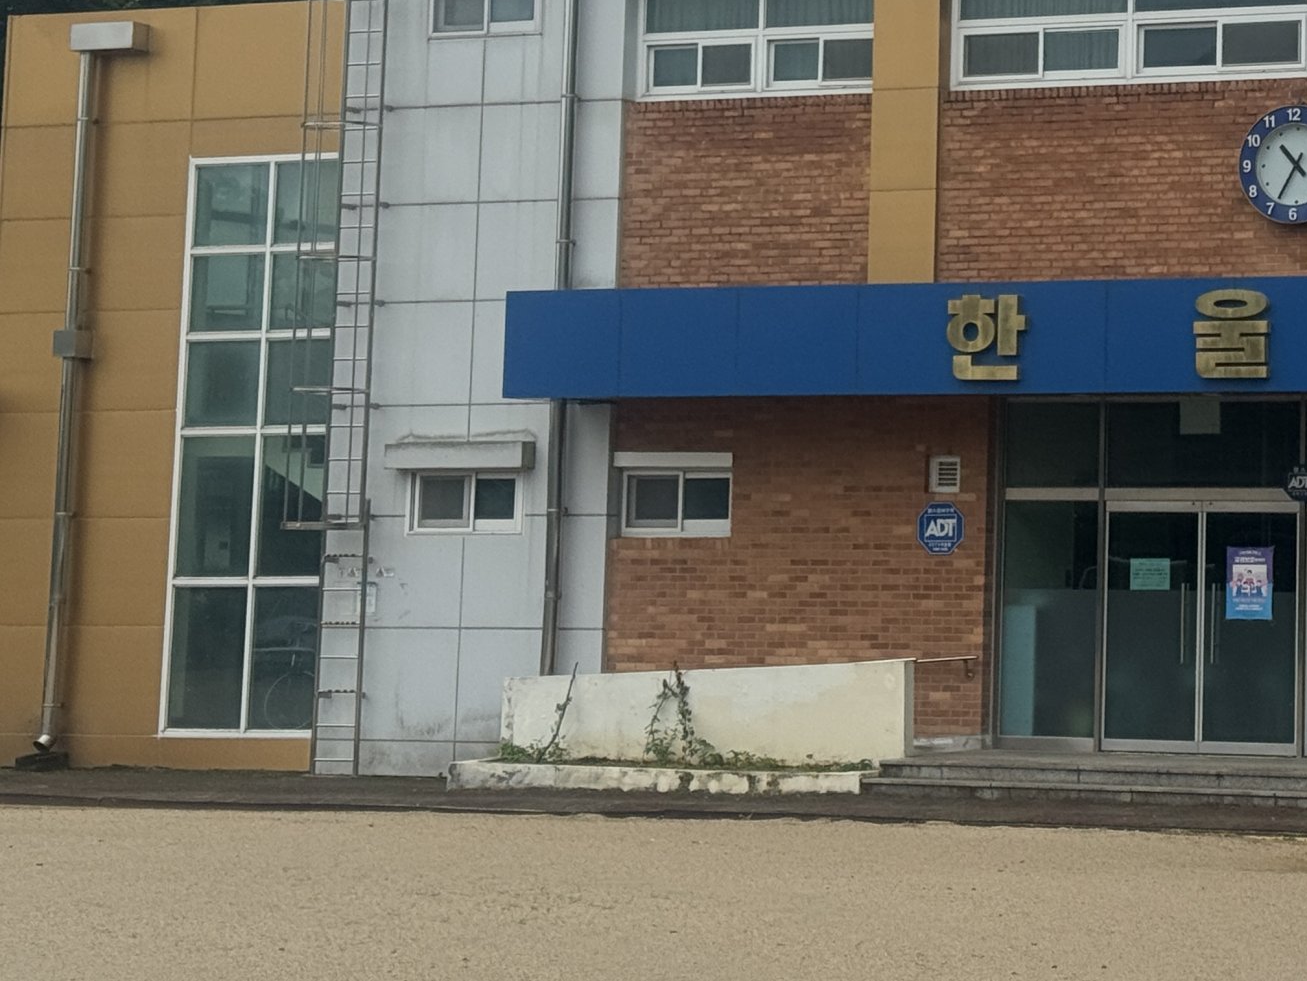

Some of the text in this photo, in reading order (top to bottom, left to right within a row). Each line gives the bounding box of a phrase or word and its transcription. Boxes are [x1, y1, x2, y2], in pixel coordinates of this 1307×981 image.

[1287, 108, 1301, 121] 12
[1263, 115, 1275, 128] 11
[1247, 134, 1260, 147] 10
[1243, 160, 1251, 173] 9
[1249, 185, 1258, 198] 8
[1266, 202, 1275, 215] 7
[1288, 208, 1297, 220] 6
[925, 518, 957, 537] ADT
